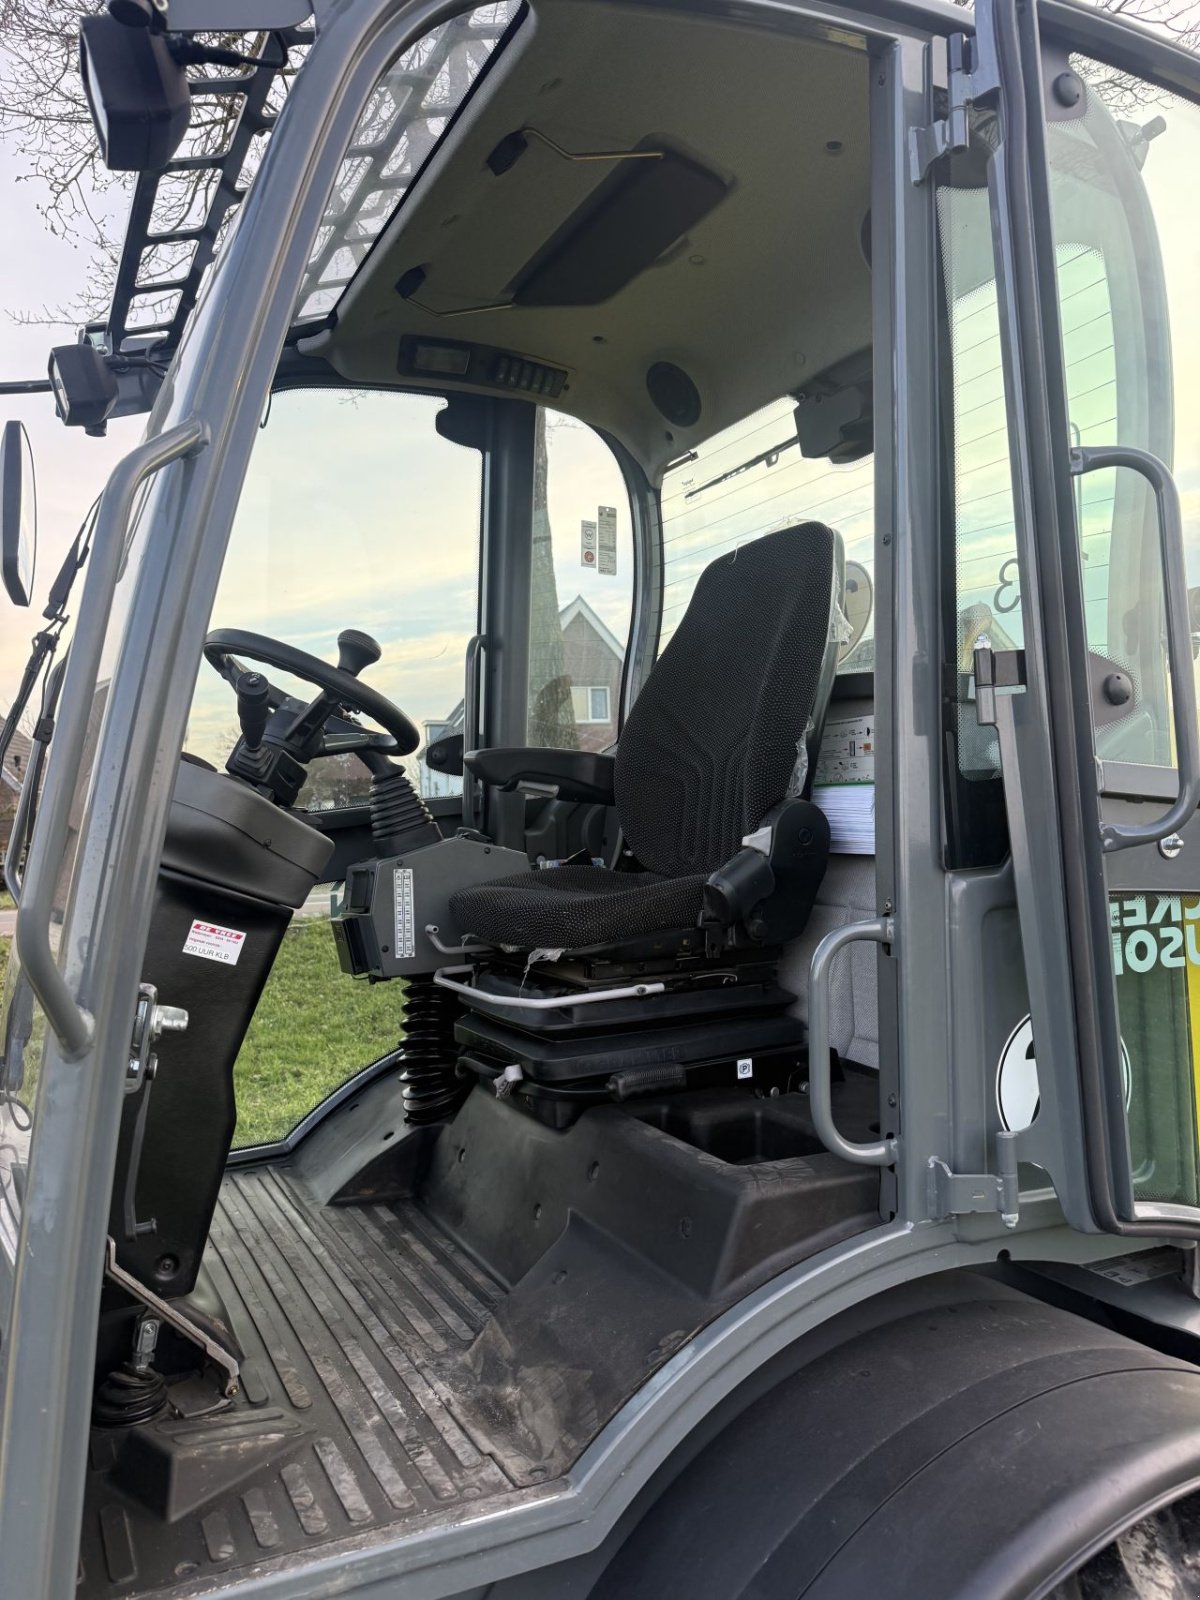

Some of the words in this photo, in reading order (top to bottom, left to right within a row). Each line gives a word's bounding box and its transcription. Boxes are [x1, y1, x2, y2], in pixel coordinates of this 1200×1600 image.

[183, 944, 198, 952] 500
[198, 947, 215, 956] UUR
[215, 951, 230, 960] KLB
